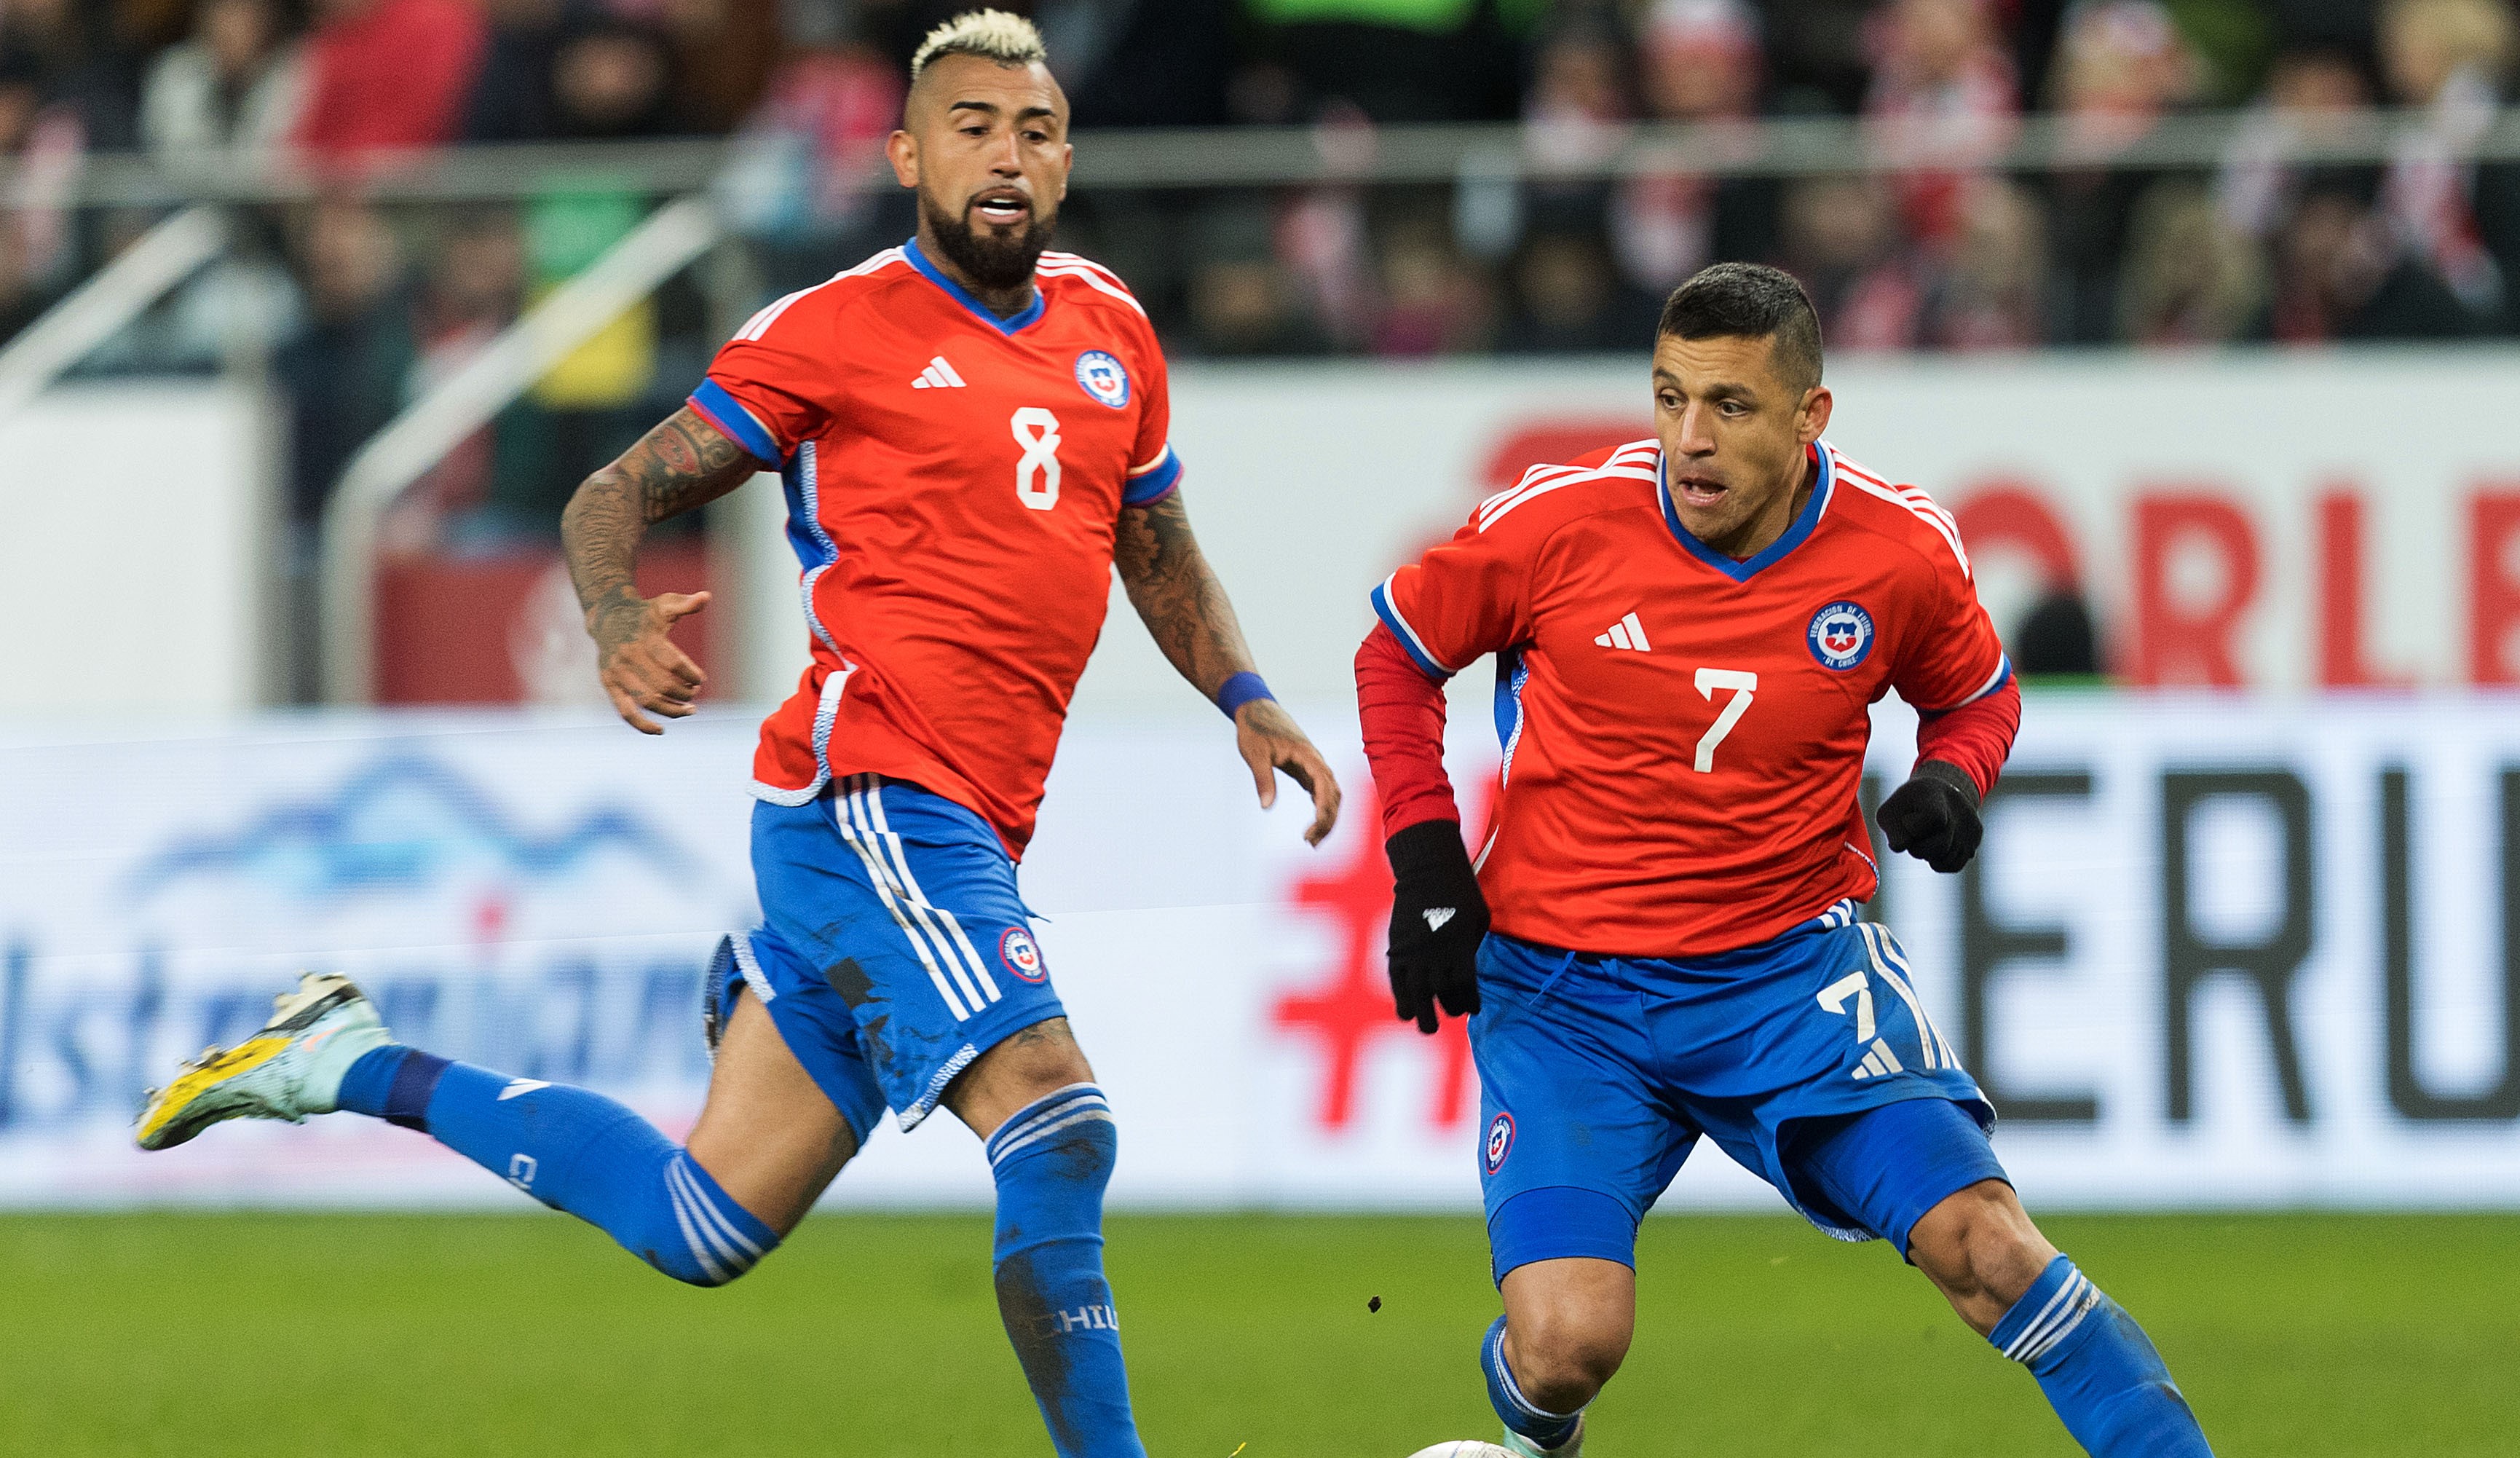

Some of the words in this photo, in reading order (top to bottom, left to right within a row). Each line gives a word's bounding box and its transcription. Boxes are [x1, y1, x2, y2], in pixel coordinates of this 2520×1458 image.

[1010, 406, 1062, 511] 8
[1809, 604, 1843, 638] FEDERACION
[1846, 605, 1857, 615] DE
[1824, 658, 1835, 666] DE
[1838, 655, 1858, 668] CHILE
[1694, 667, 1758, 773] 7
[1816, 970, 1876, 1045] 7
